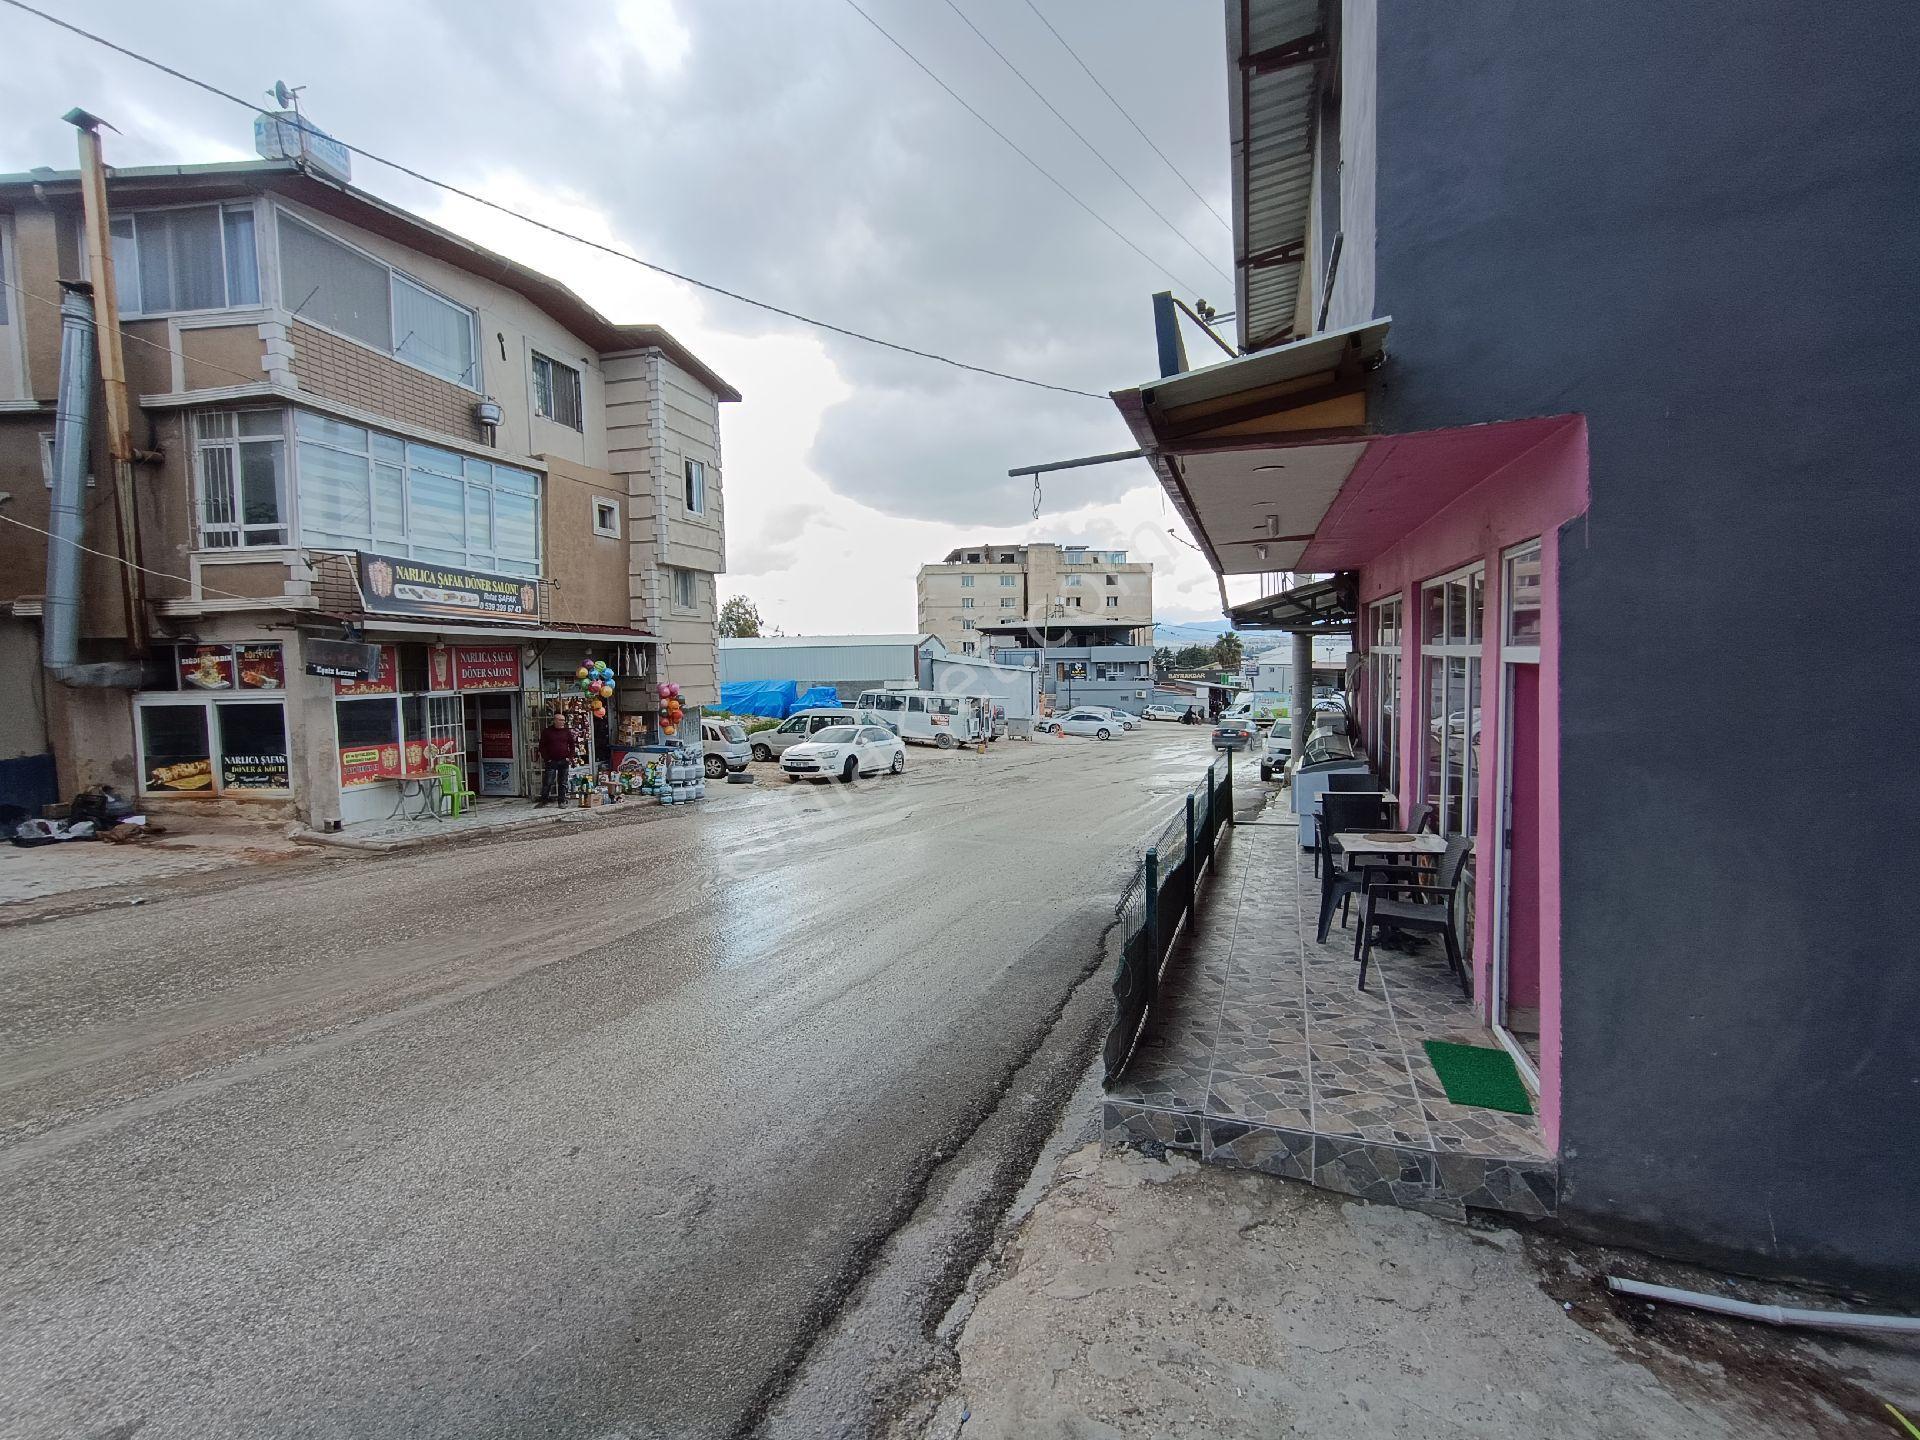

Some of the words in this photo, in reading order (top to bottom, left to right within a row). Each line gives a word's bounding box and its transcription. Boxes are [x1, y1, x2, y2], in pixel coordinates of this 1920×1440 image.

[396, 565, 436, 585] NARLICA
[437, 572, 463, 589] ŞAFAK
[465, 574, 492, 592] DÖNER
[492, 580, 520, 596] SALONU
[460, 651, 491, 663] NARLICA
[492, 651, 514, 665] ŞAFAK
[462, 665, 487, 679] DÖNER
[225, 755, 259, 765] NARLICA
[260, 755, 286, 765] ŞAFAK
